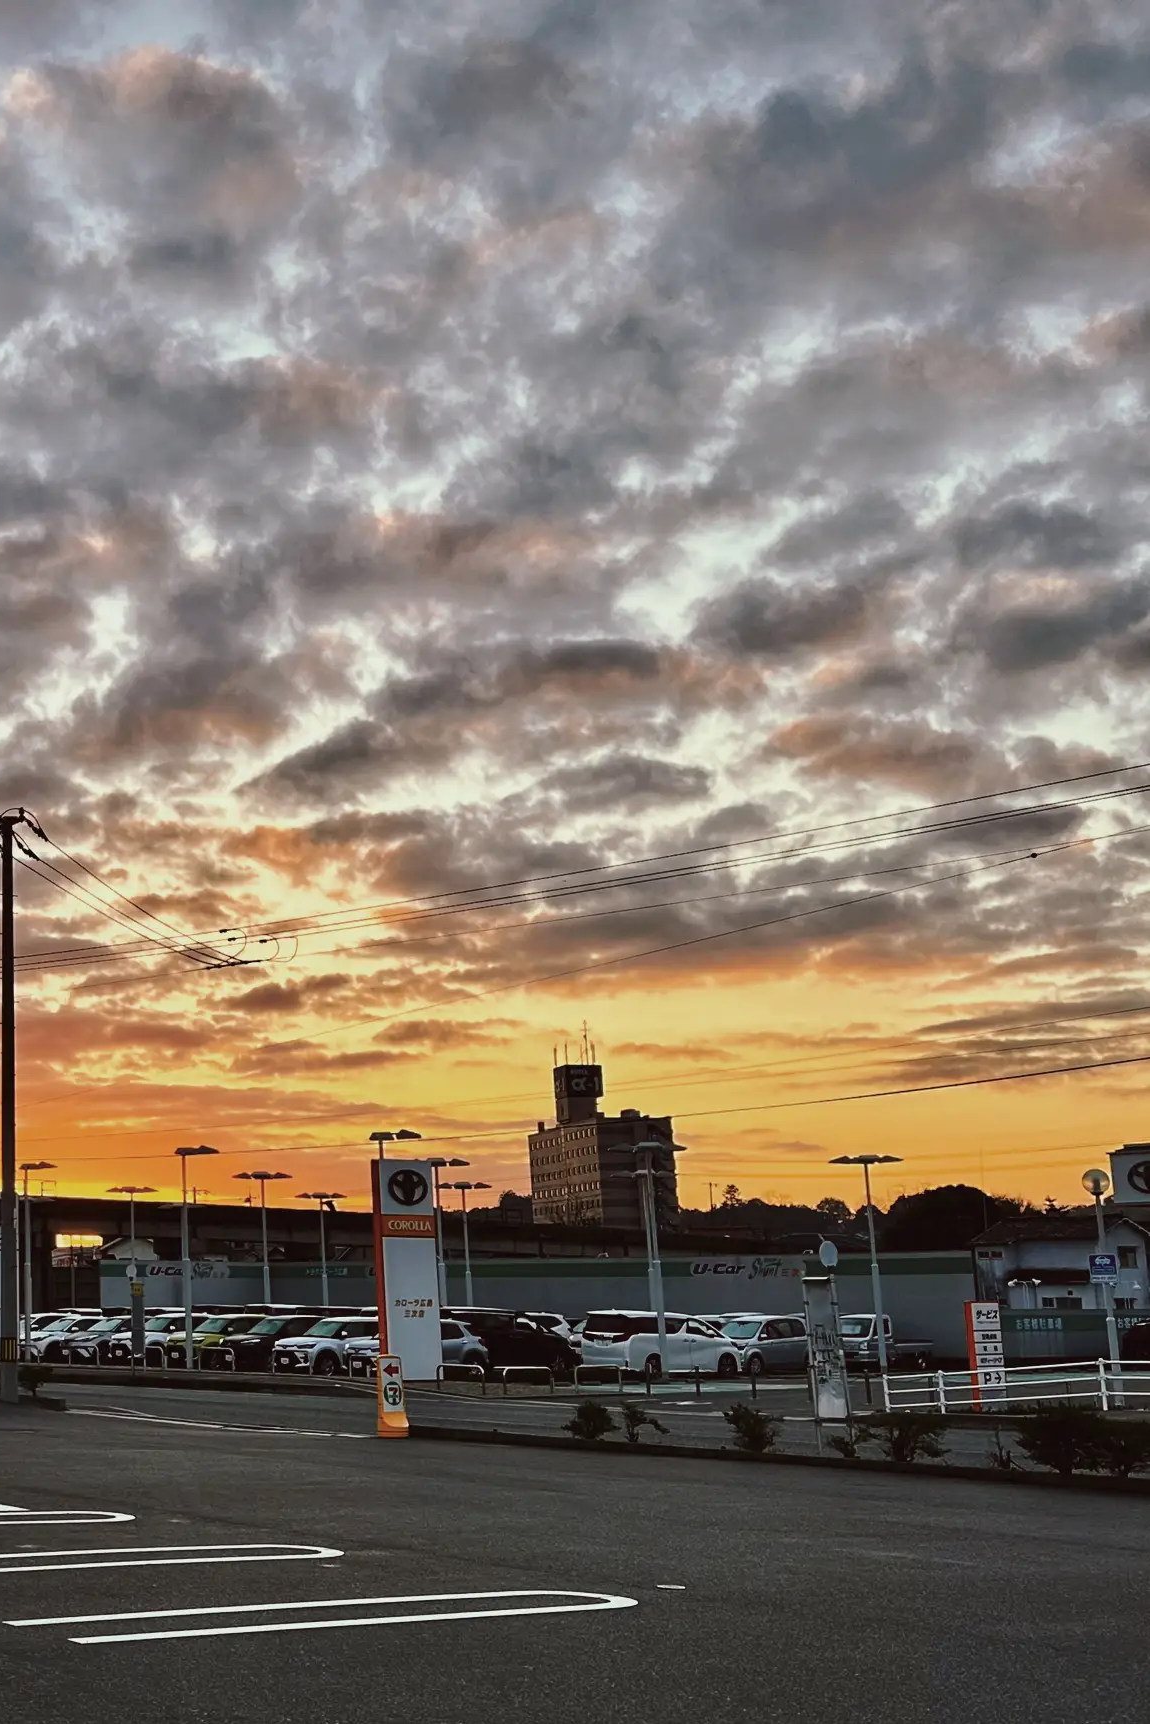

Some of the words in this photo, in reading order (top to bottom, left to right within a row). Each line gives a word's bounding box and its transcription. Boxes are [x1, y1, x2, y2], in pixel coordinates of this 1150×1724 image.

[388, 1220, 431, 1231] COROLLA
[693, 1263, 746, 1275] U-Car
[976, 1309, 998, 1320] サービス
[984, 1372, 992, 1385] P
